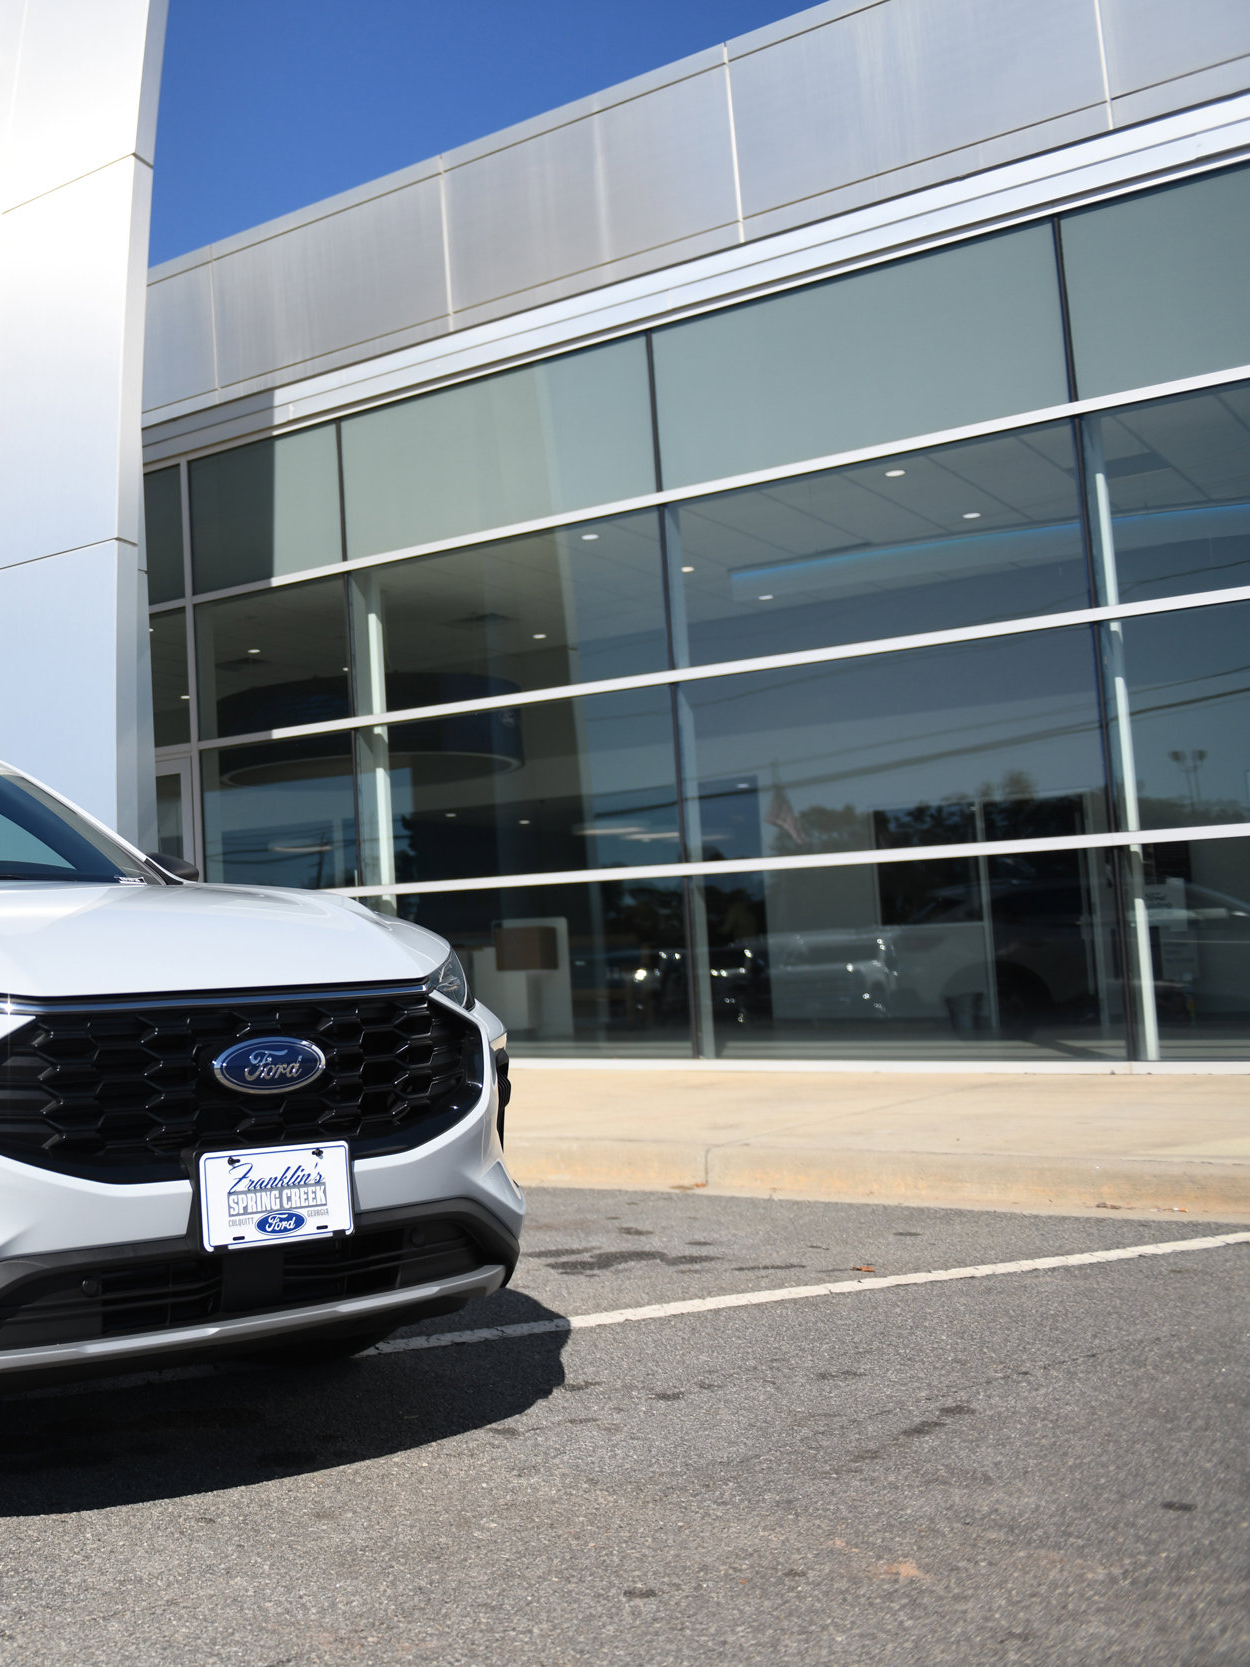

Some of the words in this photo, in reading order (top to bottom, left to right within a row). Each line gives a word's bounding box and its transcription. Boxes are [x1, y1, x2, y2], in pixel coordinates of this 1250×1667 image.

[244, 1049, 303, 1082] Ford
[228, 1162, 326, 1194] Franklin's
[229, 1190, 281, 1215] SPRING
[282, 1185, 327, 1209] CREEK
[228, 1217, 254, 1228] COLQUITT
[265, 1213, 296, 1232] Ford
[307, 1207, 330, 1218] GEORGIA
